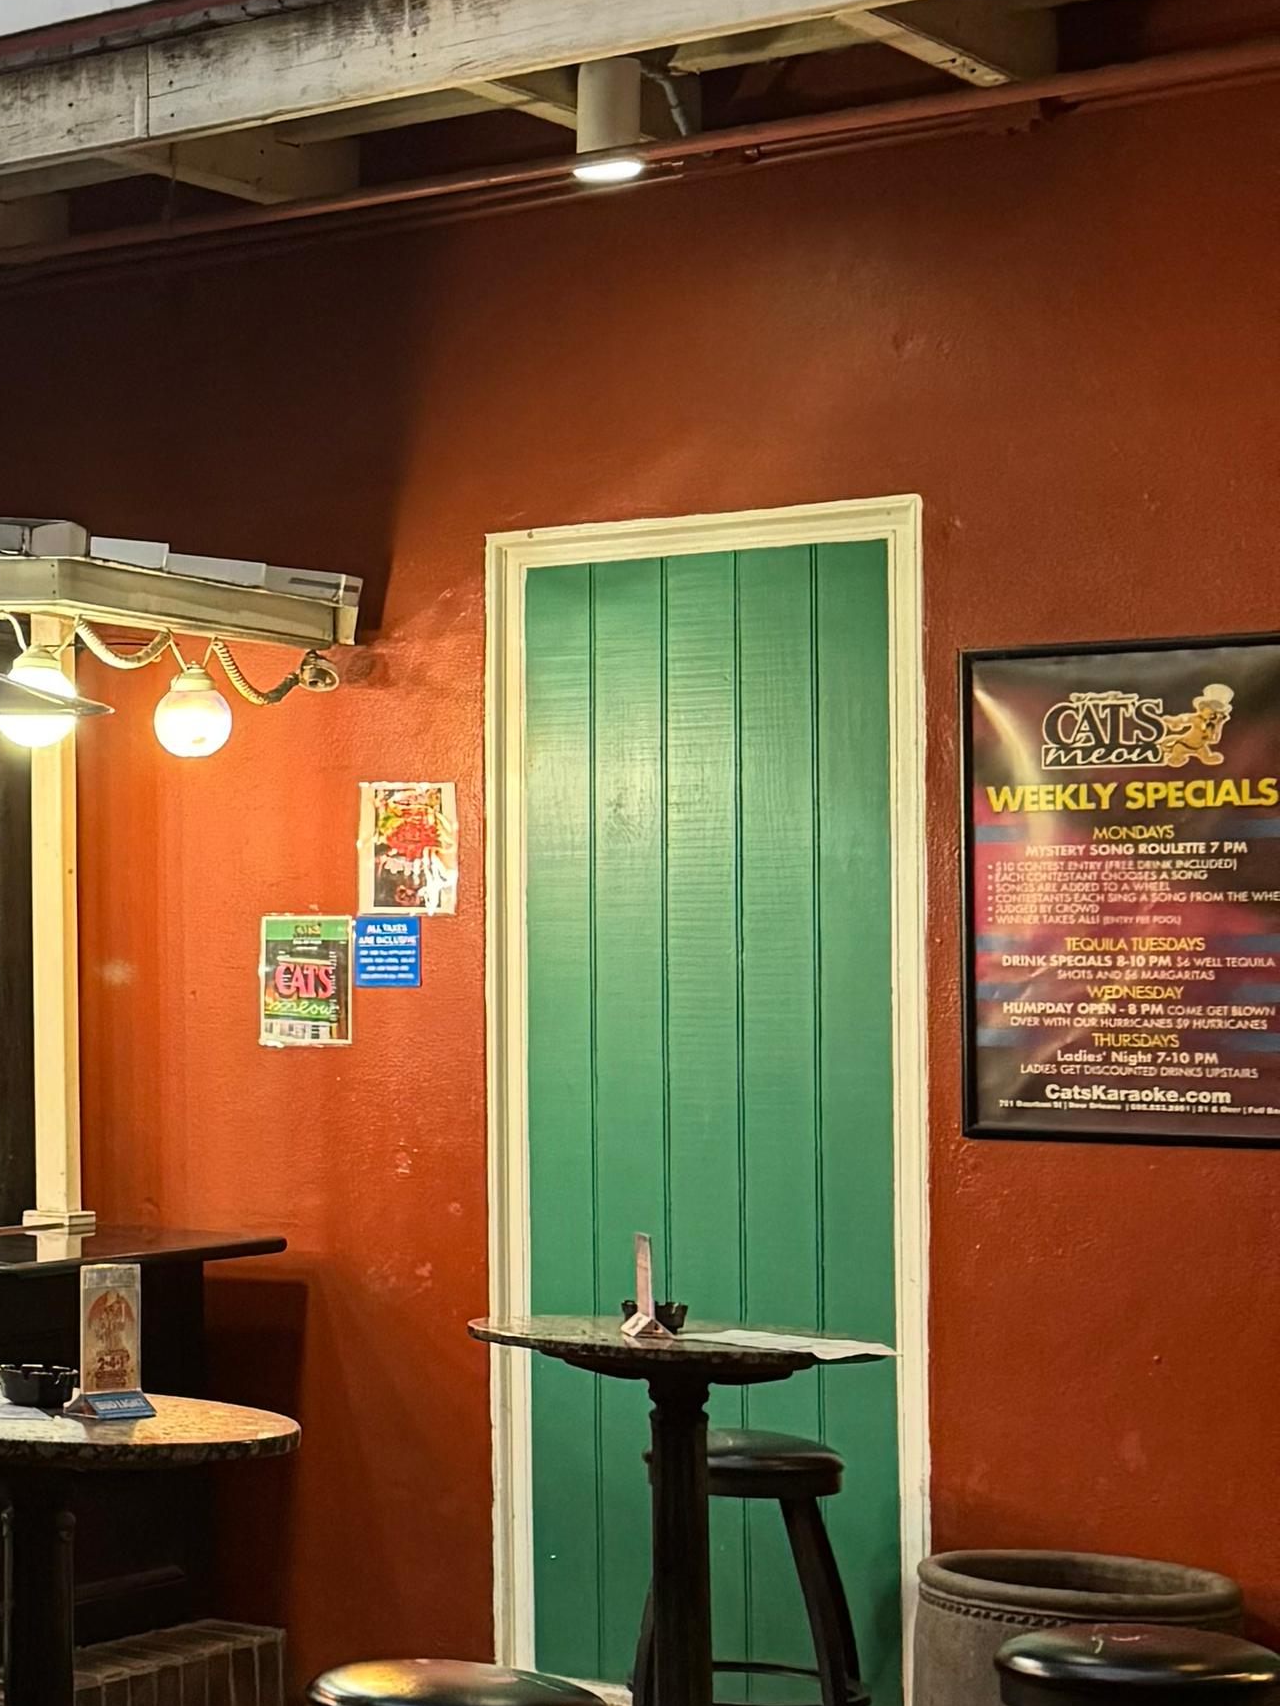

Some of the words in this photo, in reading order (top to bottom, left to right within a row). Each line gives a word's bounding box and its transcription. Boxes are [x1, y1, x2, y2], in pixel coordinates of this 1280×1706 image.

[1046, 747, 1161, 766] meow
[986, 782, 1118, 813] WEEKLY
[1125, 778, 1279, 810] SPECIALS
[1093, 825, 1175, 840] MONDAYS
[1025, 845, 1087, 856] MYSTERY
[1090, 843, 1135, 855] SONG
[1138, 842, 1207, 854] ROULETTE
[1210, 842, 1220, 853] 7
[1224, 841, 1248, 853] PM
[995, 861, 1014, 872] $10
[1017, 861, 1064, 871] CONTEST
[1068, 861, 1102, 871] ENTRY
[1105, 860, 1134, 872] (FREE
[1137, 860, 1172, 870] DRINK
[1175, 858, 1237, 871] INCLUDED)
[995, 872, 1024, 882] EACH
[1026, 872, 1097, 882] CONTESTANT
[1101, 871, 1157, 881] CHOOSES
[1160, 871, 1169, 880] A
[1170, 870, 1208, 880] SONG
[995, 883, 1035, 893] SONGS
[1037, 883, 1057, 892] ARE
[1060, 882, 1099, 892] ADDED
[1103, 882, 1118, 892] TO
[1121, 882, 1130, 891] A
[1133, 881, 1171, 891] WHEEL
[995, 893, 1071, 903] CONTESTANTS
[1074, 893, 1105, 902] EACH
[1108, 893, 1137, 902] SING
[1140, 892, 1149, 902] A
[1151, 892, 1187, 902] SONG
[1190, 892, 1224, 902] FROM
[1226, 891, 1249, 901] THE
[995, 904, 1037, 913] JUDGED
[1040, 904, 1052, 913] BY
[1055, 904, 1100, 913] CROWD
[995, 915, 1040, 925] WINNER
[1042, 915, 1075, 924] TAKES
[1064, 937, 1128, 951] TEQUILA
[1130, 937, 1206, 951] TUESDAYS
[1002, 955, 1047, 967] DRINK
[1049, 955, 1112, 967] SPECIALS
[1116, 955, 1146, 967] 8-10
[1149, 955, 1172, 967] PM
[1193, 957, 1224, 967] WELL
[1225, 957, 1276, 967] TEQUILA
[1057, 969, 1093, 980] SHOTS
[1095, 970, 1122, 980] AND
[1141, 970, 1215, 980] MARGARITAS
[1087, 985, 1184, 999] WEDNESDAY
[1003, 1002, 1074, 1014] HUMPDAY
[1077, 1003, 1117, 1014] OPEN
[1128, 1004, 1137, 1015] 8
[1140, 1004, 1164, 1015] PM
[1167, 1005, 1203, 1016] COME
[1206, 1006, 1229, 1016] GET
[1231, 1005, 1276, 1016] BLOWN
[1010, 1016, 1040, 1026] OVER
[1042, 1016, 1071, 1027] WITH
[1073, 1017, 1098, 1027] OUR
[1100, 1018, 1172, 1028] HURRICANES
[1192, 1019, 1268, 1030] HURRICANES
[1092, 1033, 1180, 1048] THURSDAYS
[1057, 1049, 1106, 1062] Ladies'
[1111, 1051, 1153, 1066] Night
[1156, 1052, 1190, 1064] 7-10
[1195, 1052, 1219, 1064] PM
[1020, 1064, 1057, 1074] LADIES
[1060, 1064, 1081, 1074] GET
[1084, 1065, 1157, 1076] DISCOUNTED
[1160, 1066, 1203, 1077] DRINKS
[1205, 1067, 1259, 1078] UPSTAIRS
[1045, 1084, 1232, 1104] CatsKaraoke.com
